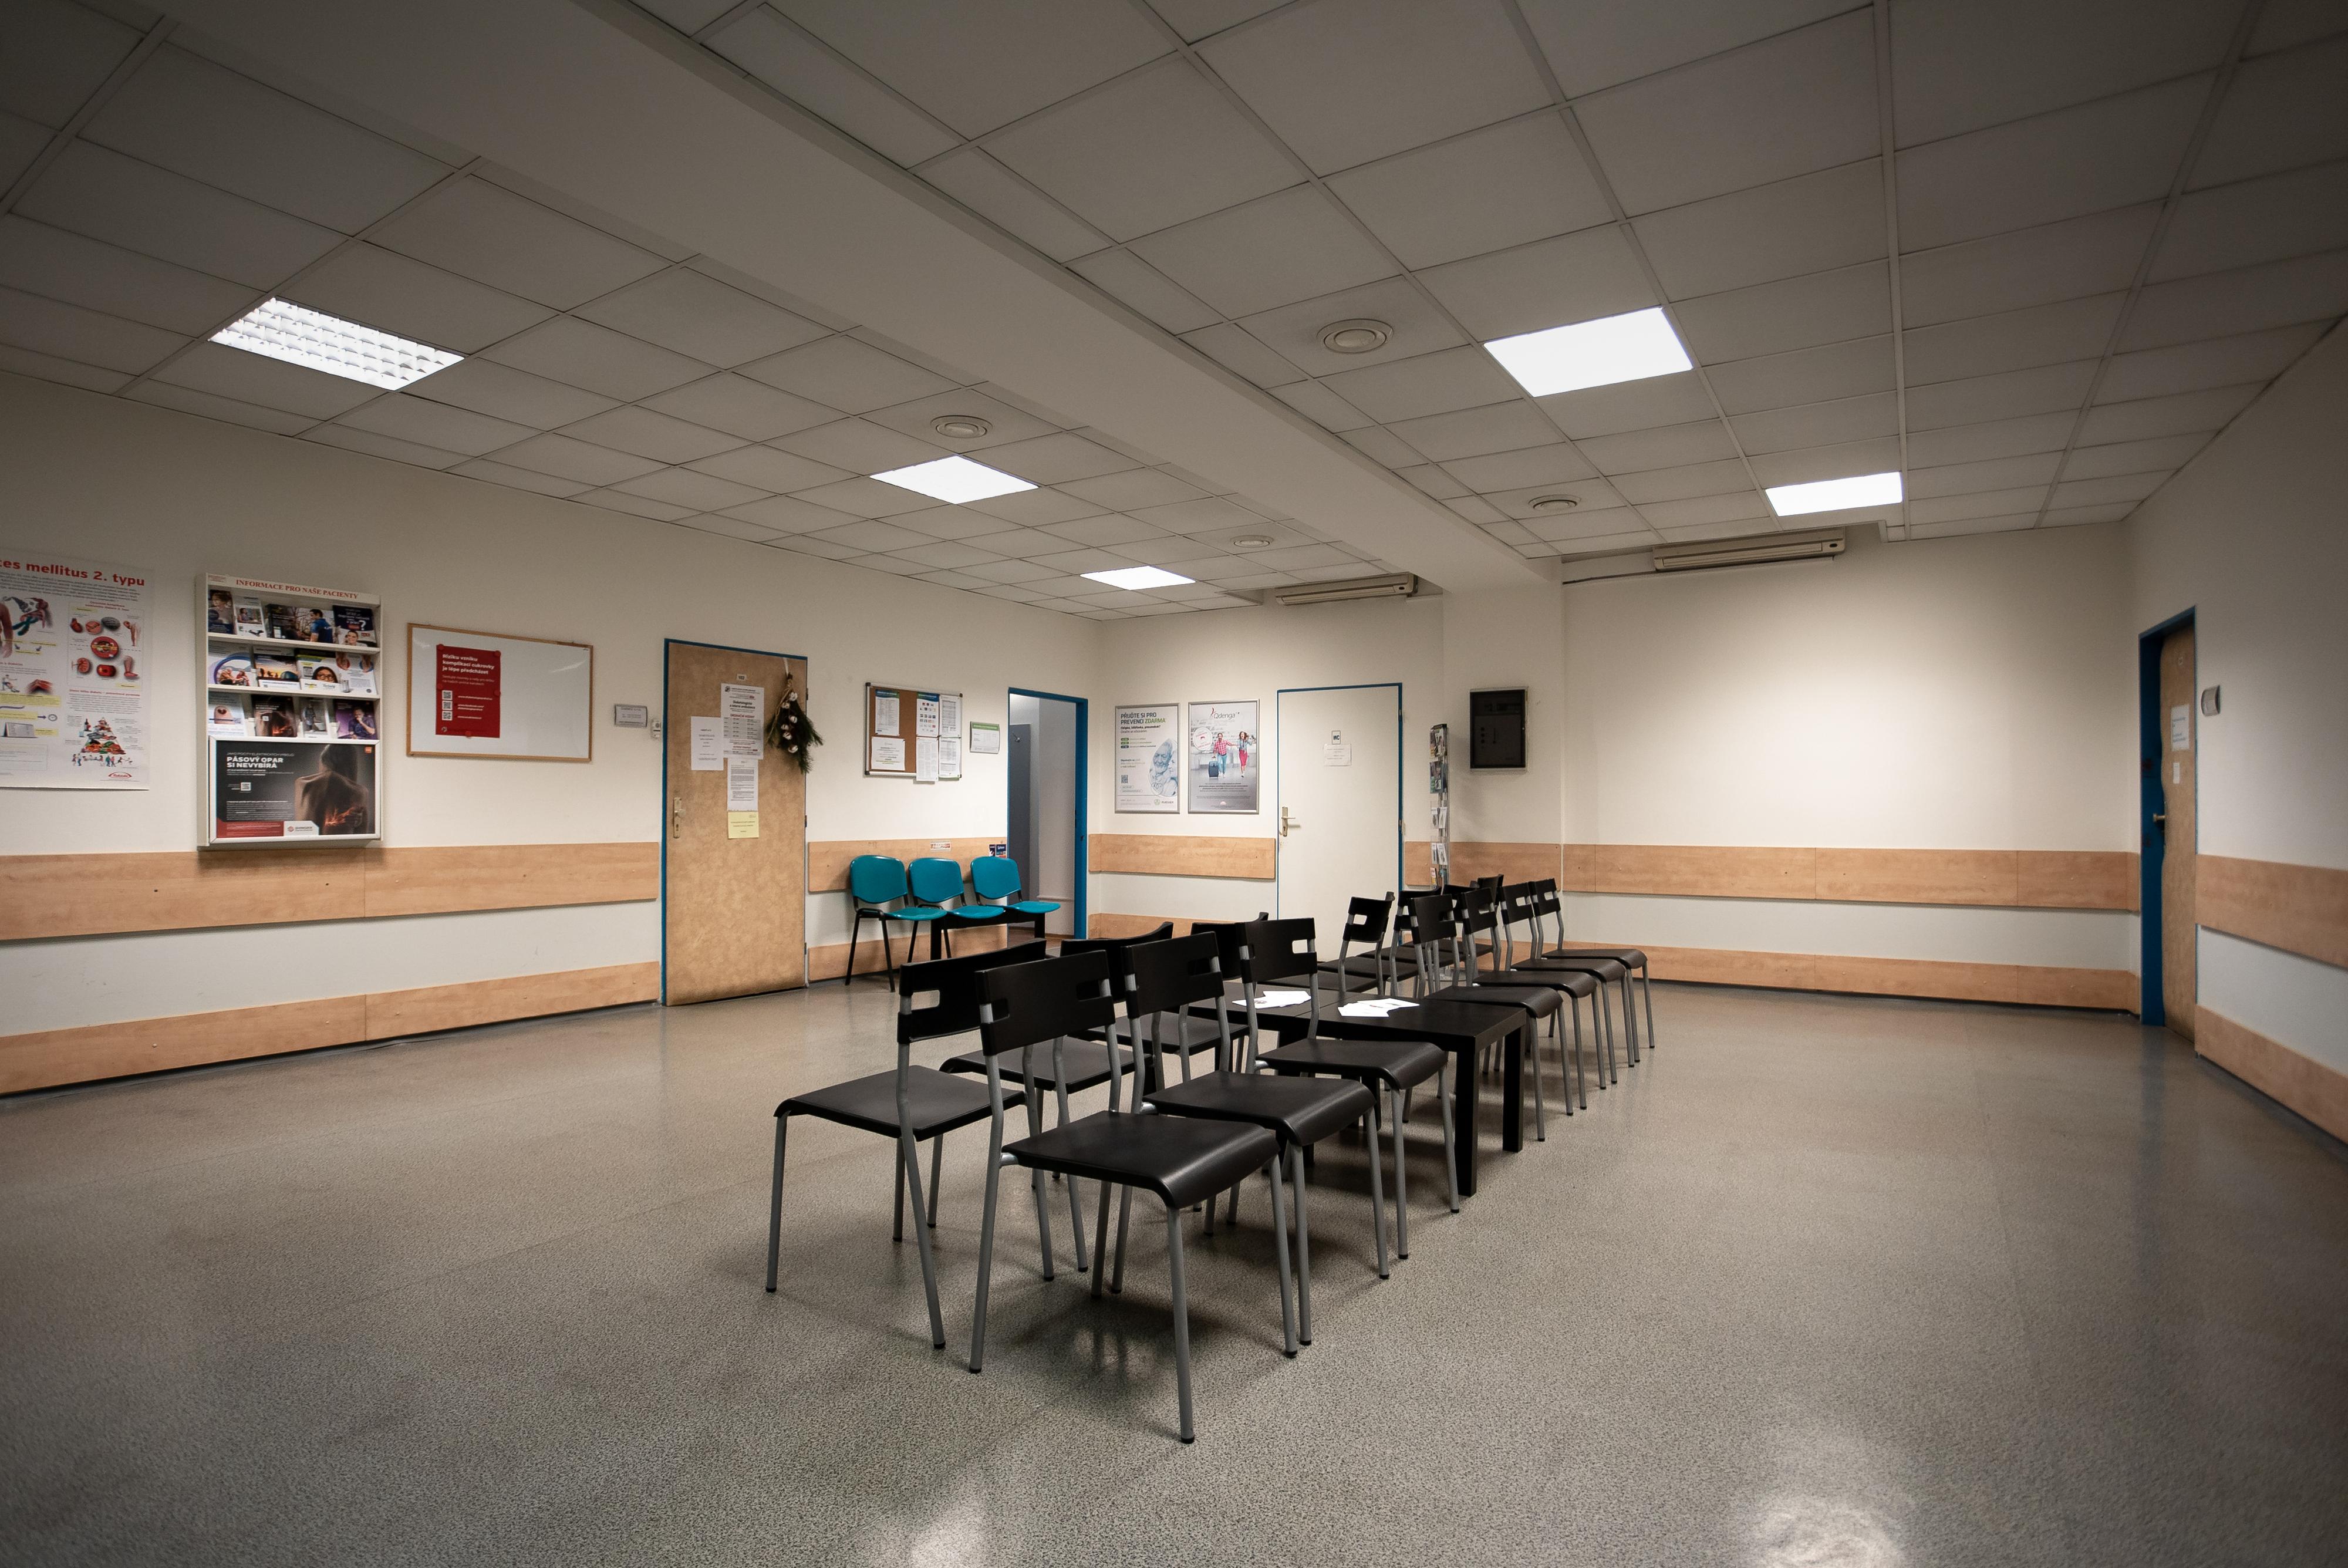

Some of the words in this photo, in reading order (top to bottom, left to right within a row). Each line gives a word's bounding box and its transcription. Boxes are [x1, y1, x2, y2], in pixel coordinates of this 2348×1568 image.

[26, 563, 88, 578] mellitus
[93, 571, 107, 581] 2.
[113, 574, 145, 586] typu
[236, 579, 284, 591] INFORMACE
[323, 590, 358, 599] PACIENTY
